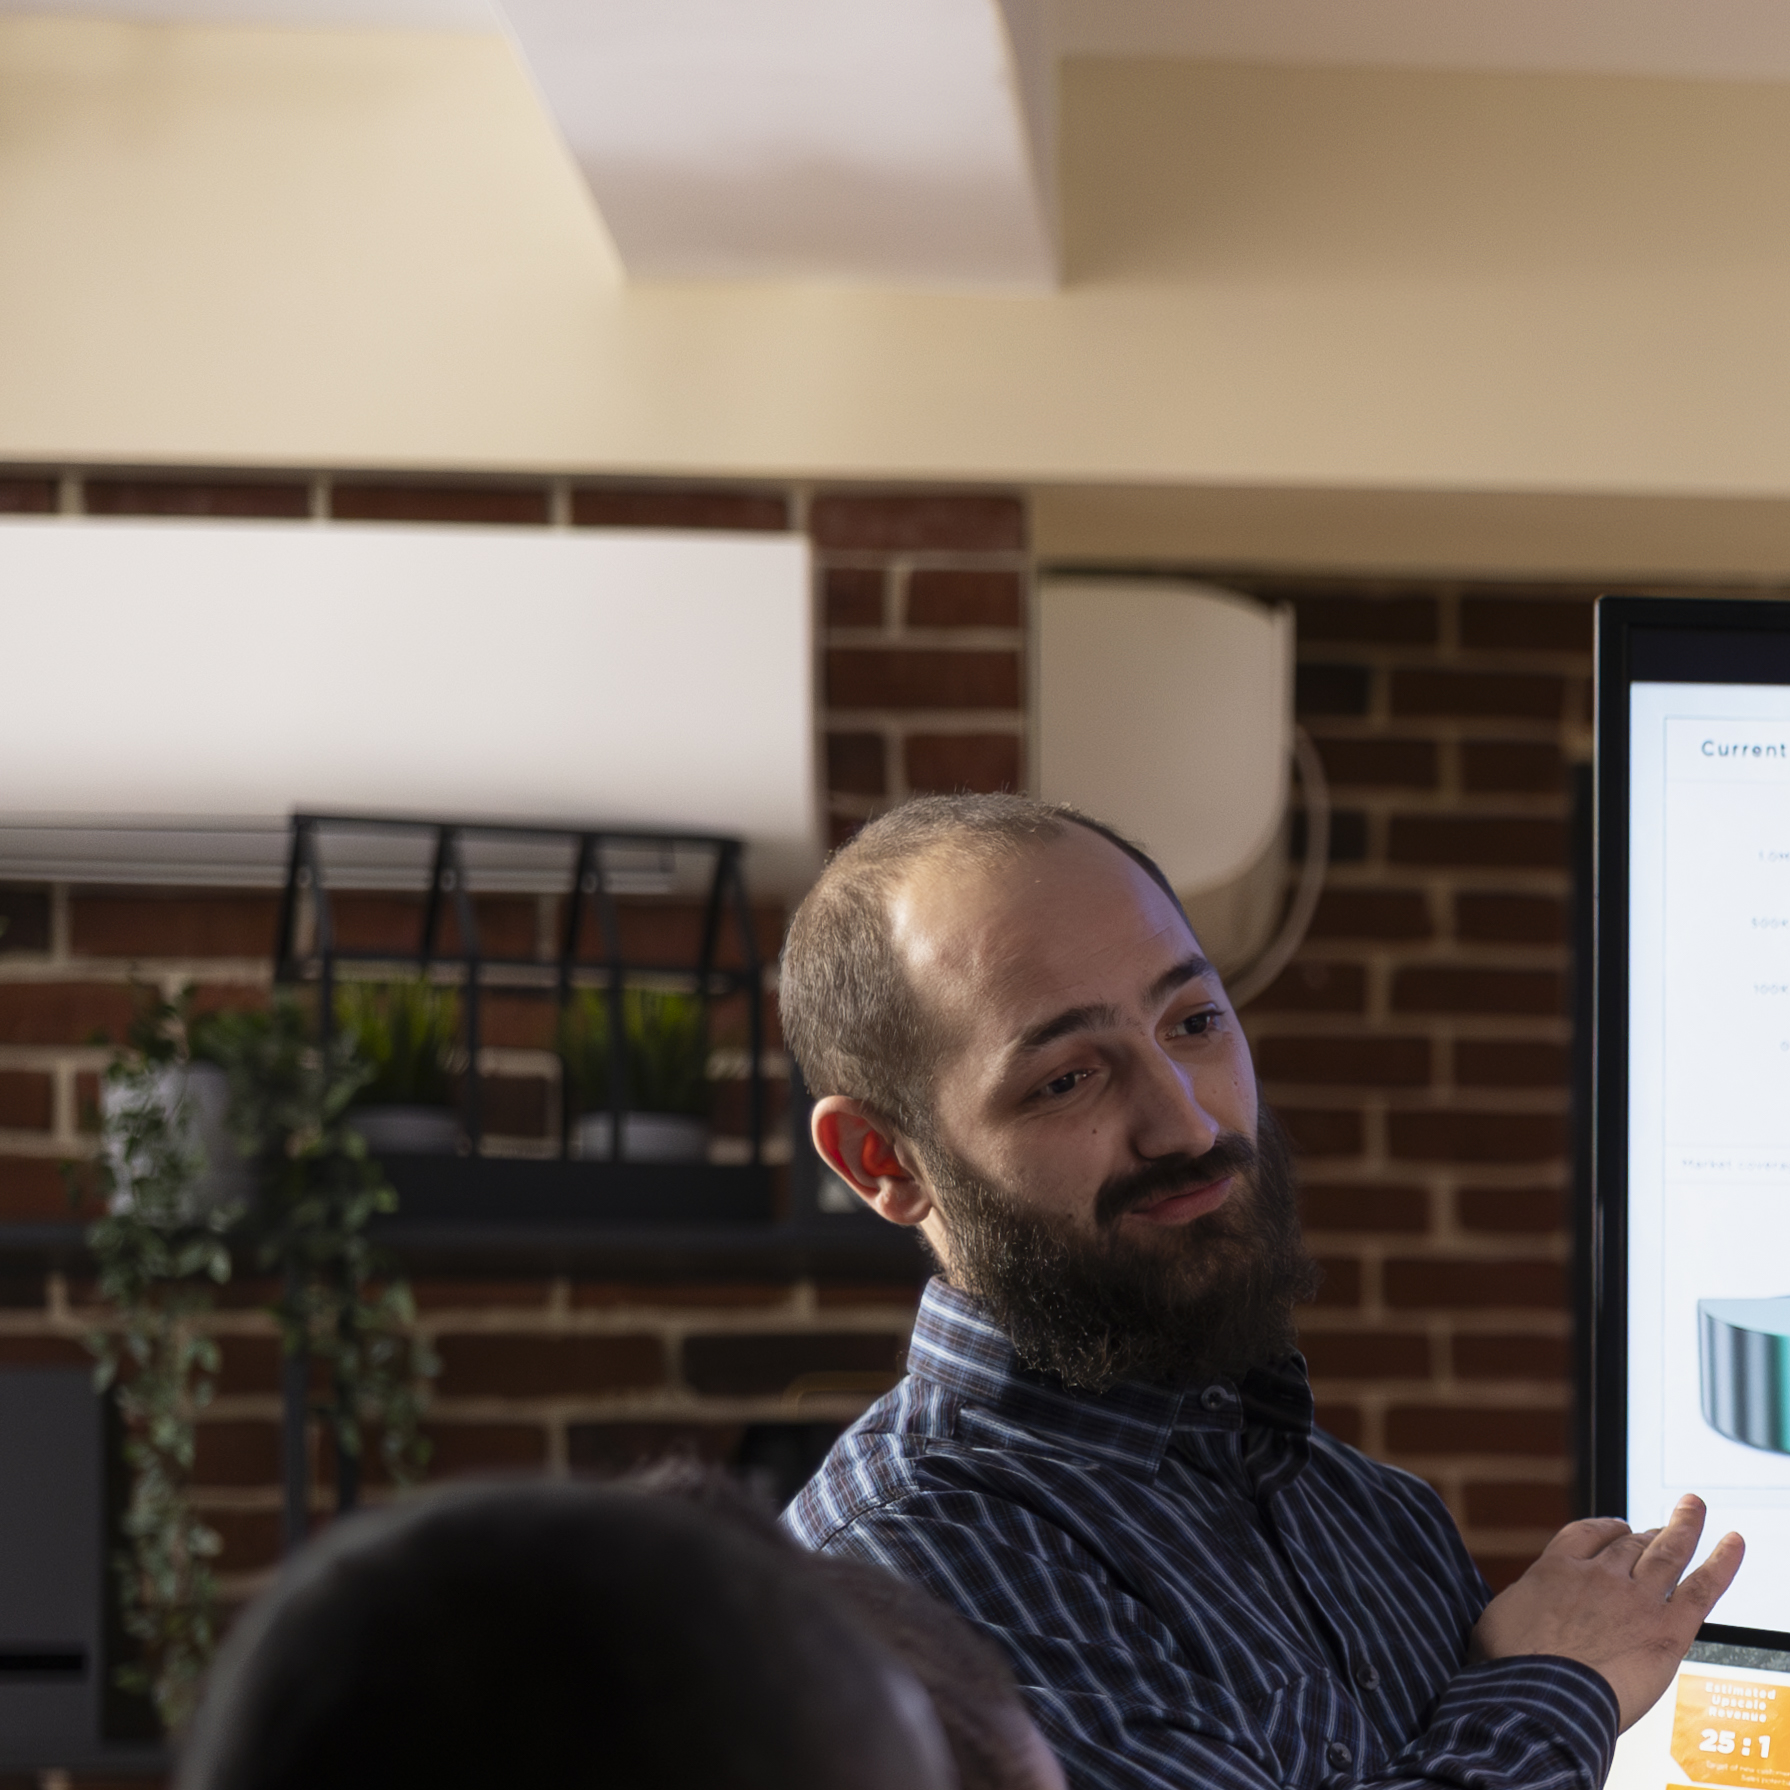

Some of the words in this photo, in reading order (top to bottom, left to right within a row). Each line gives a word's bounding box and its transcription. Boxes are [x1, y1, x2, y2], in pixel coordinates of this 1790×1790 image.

[1701, 739, 1786, 758] Current
[1704, 1681, 1777, 1700] Estimated
[1711, 1695, 1767, 1711] Upscale
[1708, 1706, 1768, 1723] Revenue
